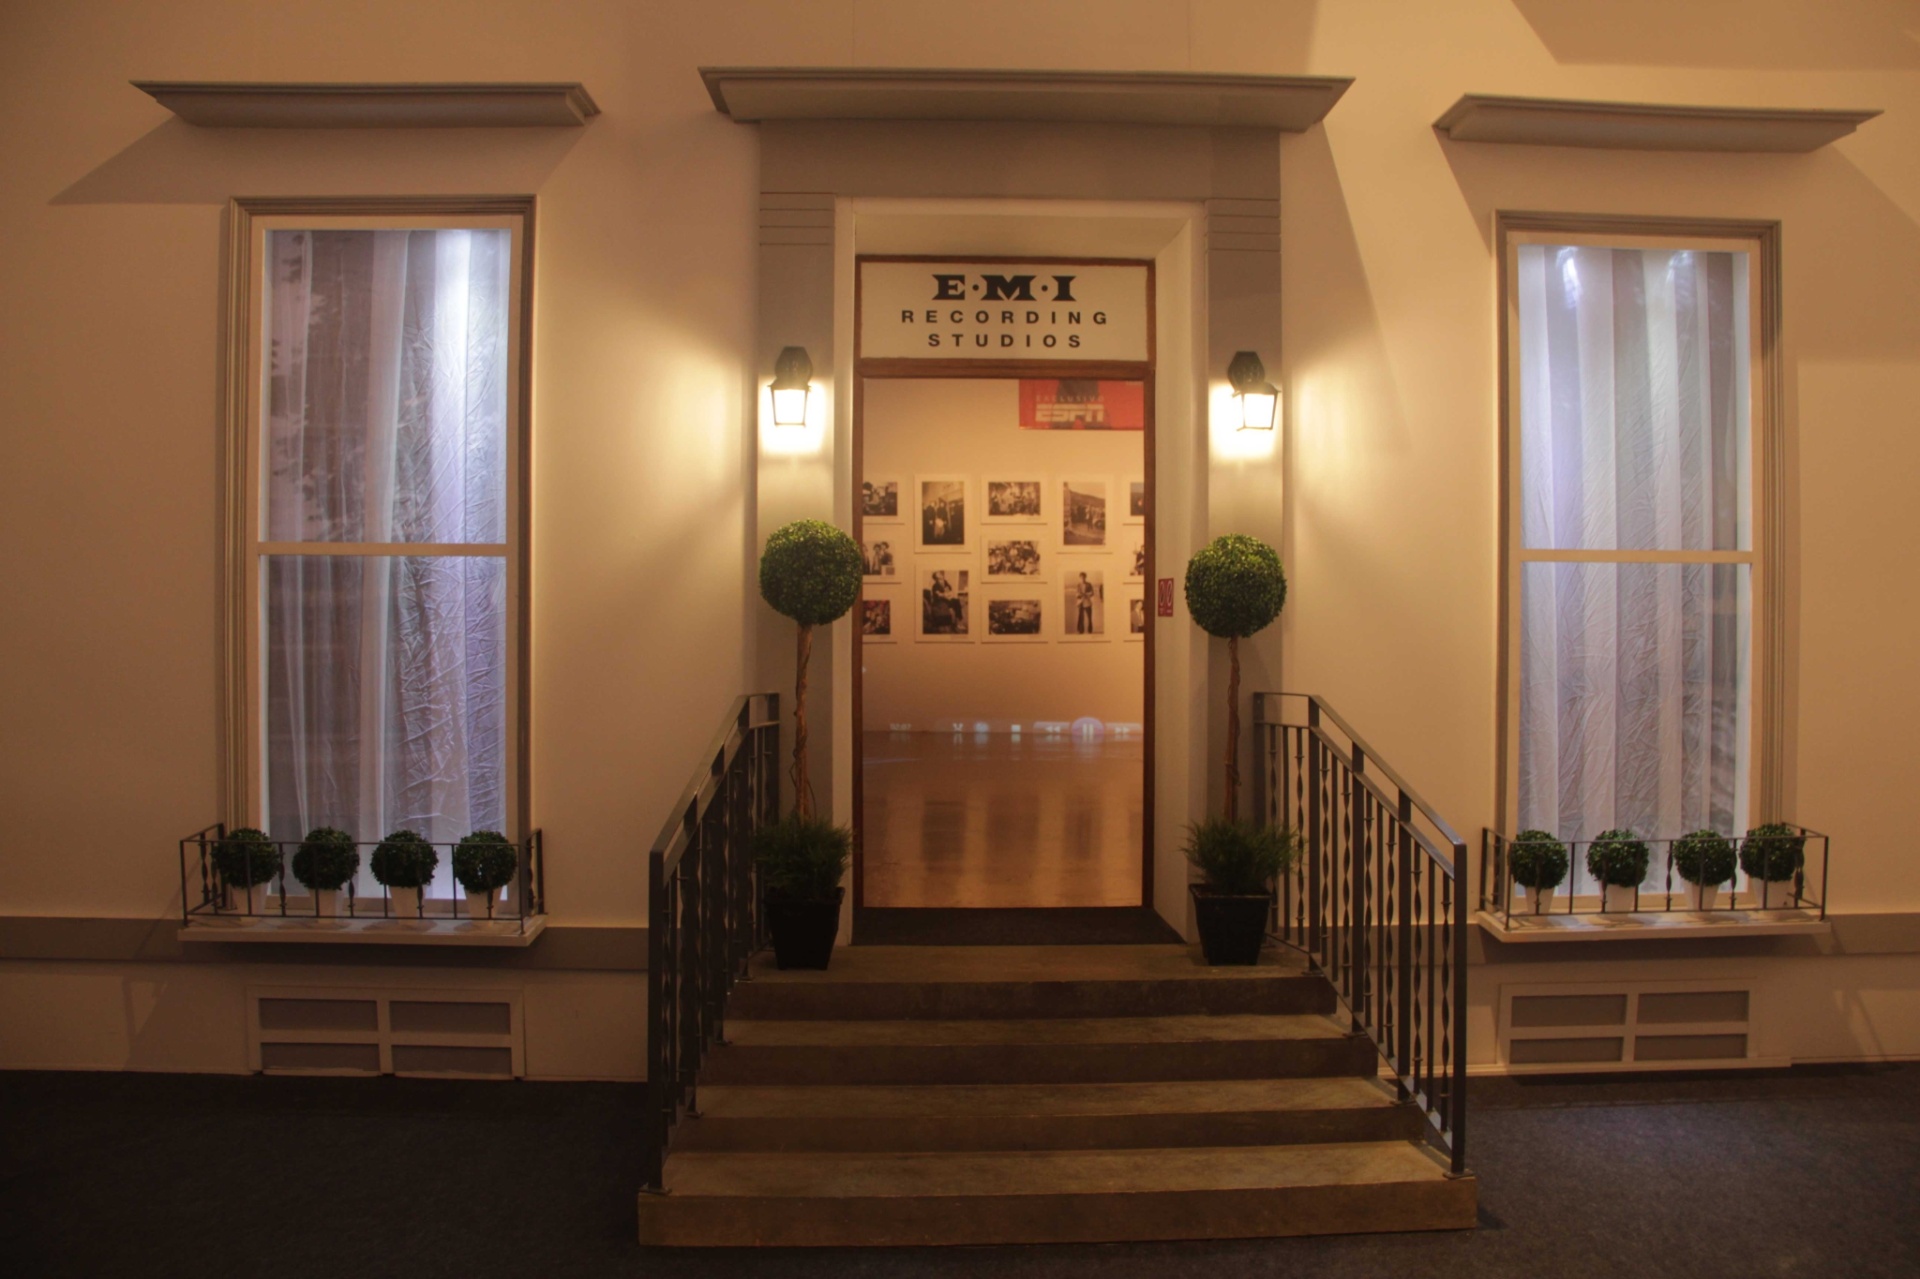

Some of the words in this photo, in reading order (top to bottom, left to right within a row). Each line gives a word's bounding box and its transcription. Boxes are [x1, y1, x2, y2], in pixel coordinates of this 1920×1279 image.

[901, 309, 1107, 325] RECORDING
[928, 333, 1081, 348] STUDIOS
[1035, 404, 1104, 422] ESPN
